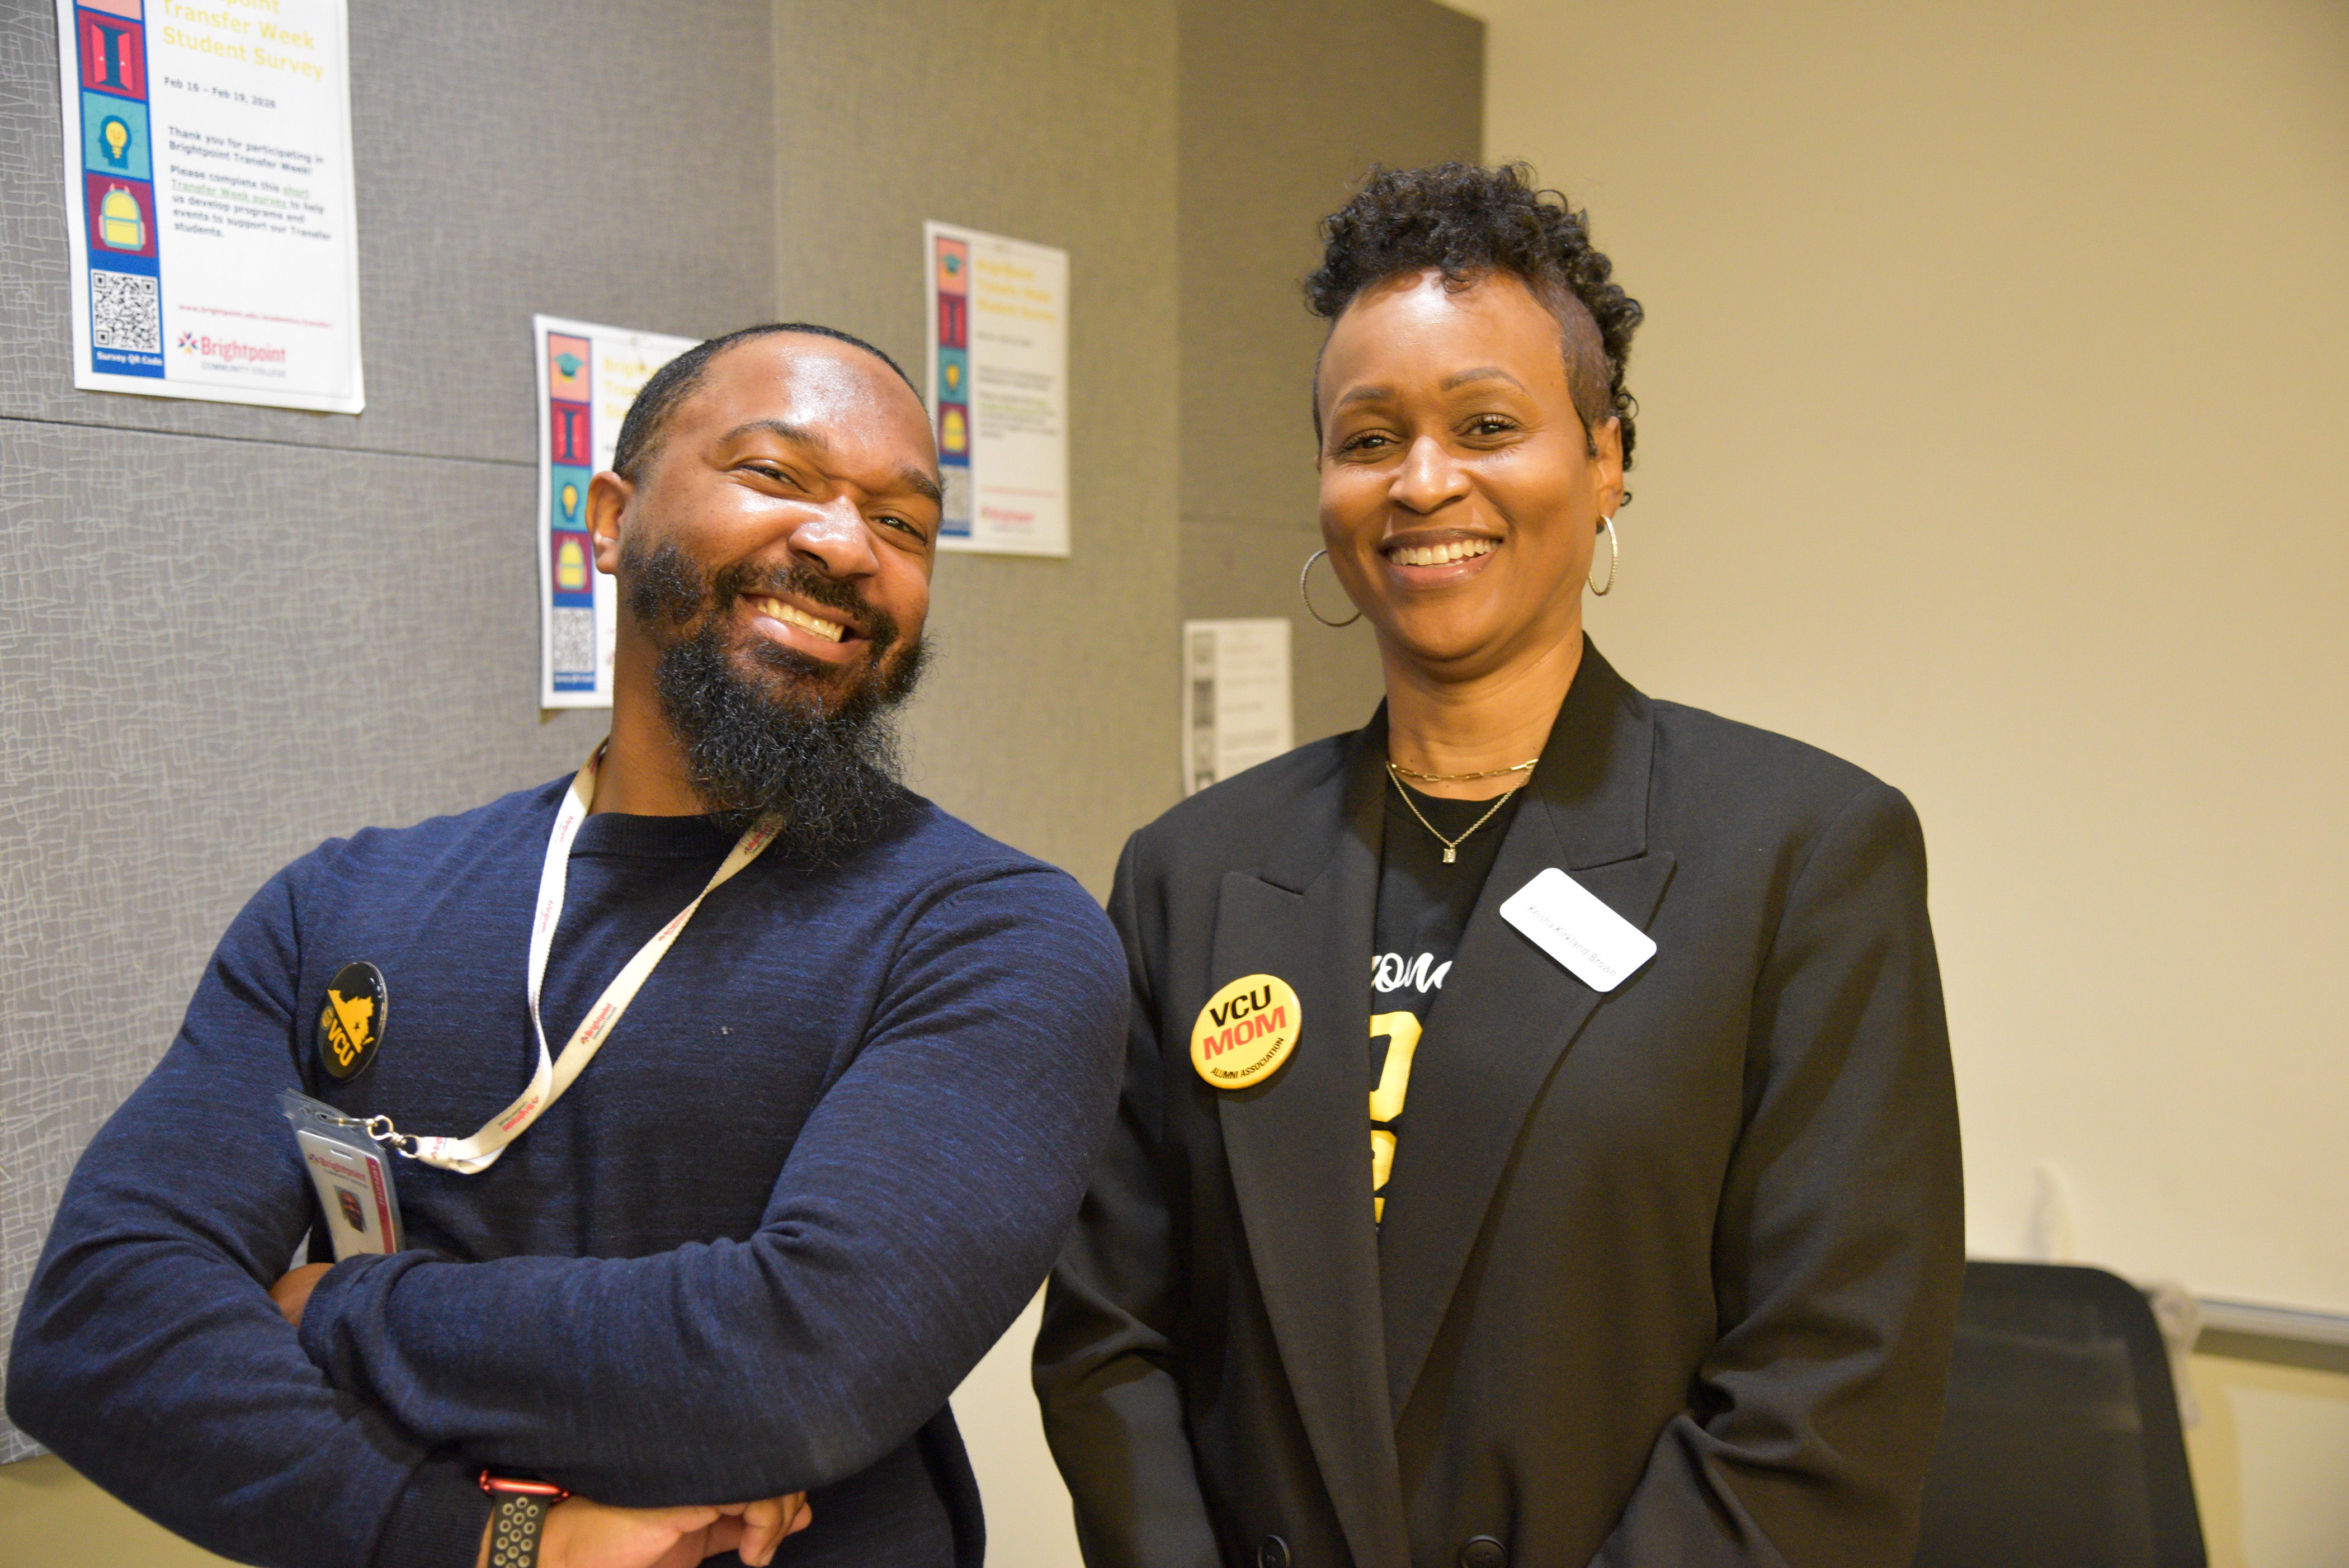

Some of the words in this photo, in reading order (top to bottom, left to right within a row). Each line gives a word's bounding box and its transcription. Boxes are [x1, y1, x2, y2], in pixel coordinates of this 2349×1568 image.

[164, 0, 251, 34] Transfer
[258, 21, 315, 50] Week
[163, 26, 247, 62] Student
[254, 48, 324, 82] Survey
[164, 76, 183, 89] Feb
[168, 126, 201, 140] Thank
[170, 164, 205, 179] Please
[201, 336, 286, 363] Brightpoint
[1527, 905, 1554, 929] Keisha
[1554, 925, 1617, 977] Kirkland-Brown
[1209, 984, 1271, 1028] VCU
[328, 1018, 355, 1066] VCU
[1203, 1005, 1287, 1061] MOM
[1210, 1067, 1239, 1079] ALUMNI
[1240, 1037, 1284, 1078] ASSOCIATION
